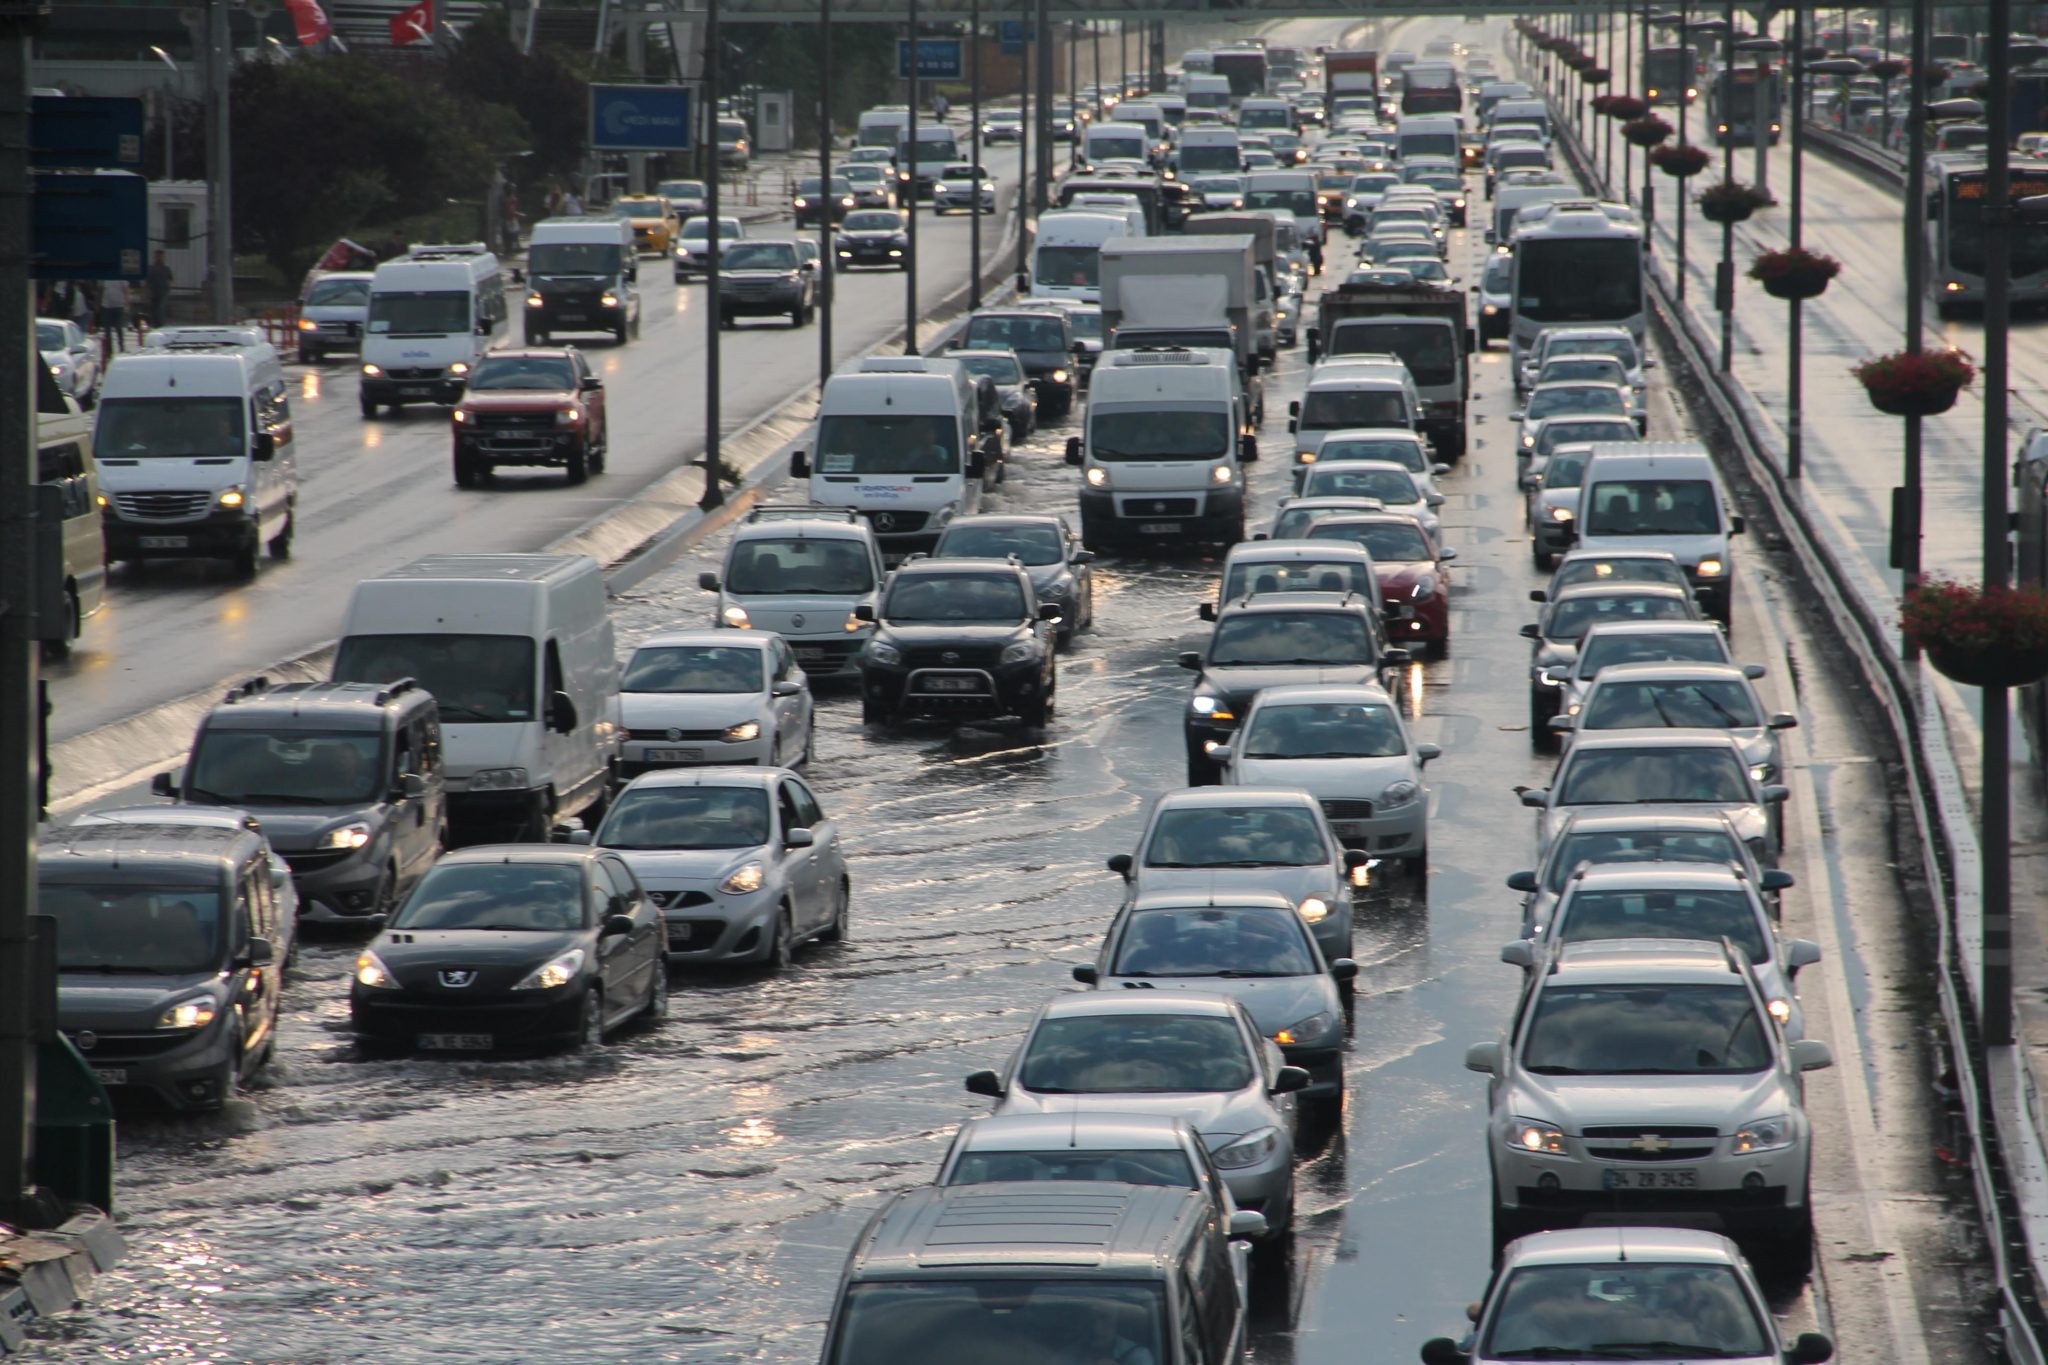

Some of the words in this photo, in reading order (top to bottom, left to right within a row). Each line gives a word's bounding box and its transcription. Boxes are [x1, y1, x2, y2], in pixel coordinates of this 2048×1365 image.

[1612, 1172, 1630, 1187] 34
[1637, 1172, 1656, 1187] ZR
[1661, 1172, 1695, 1187] 3425
